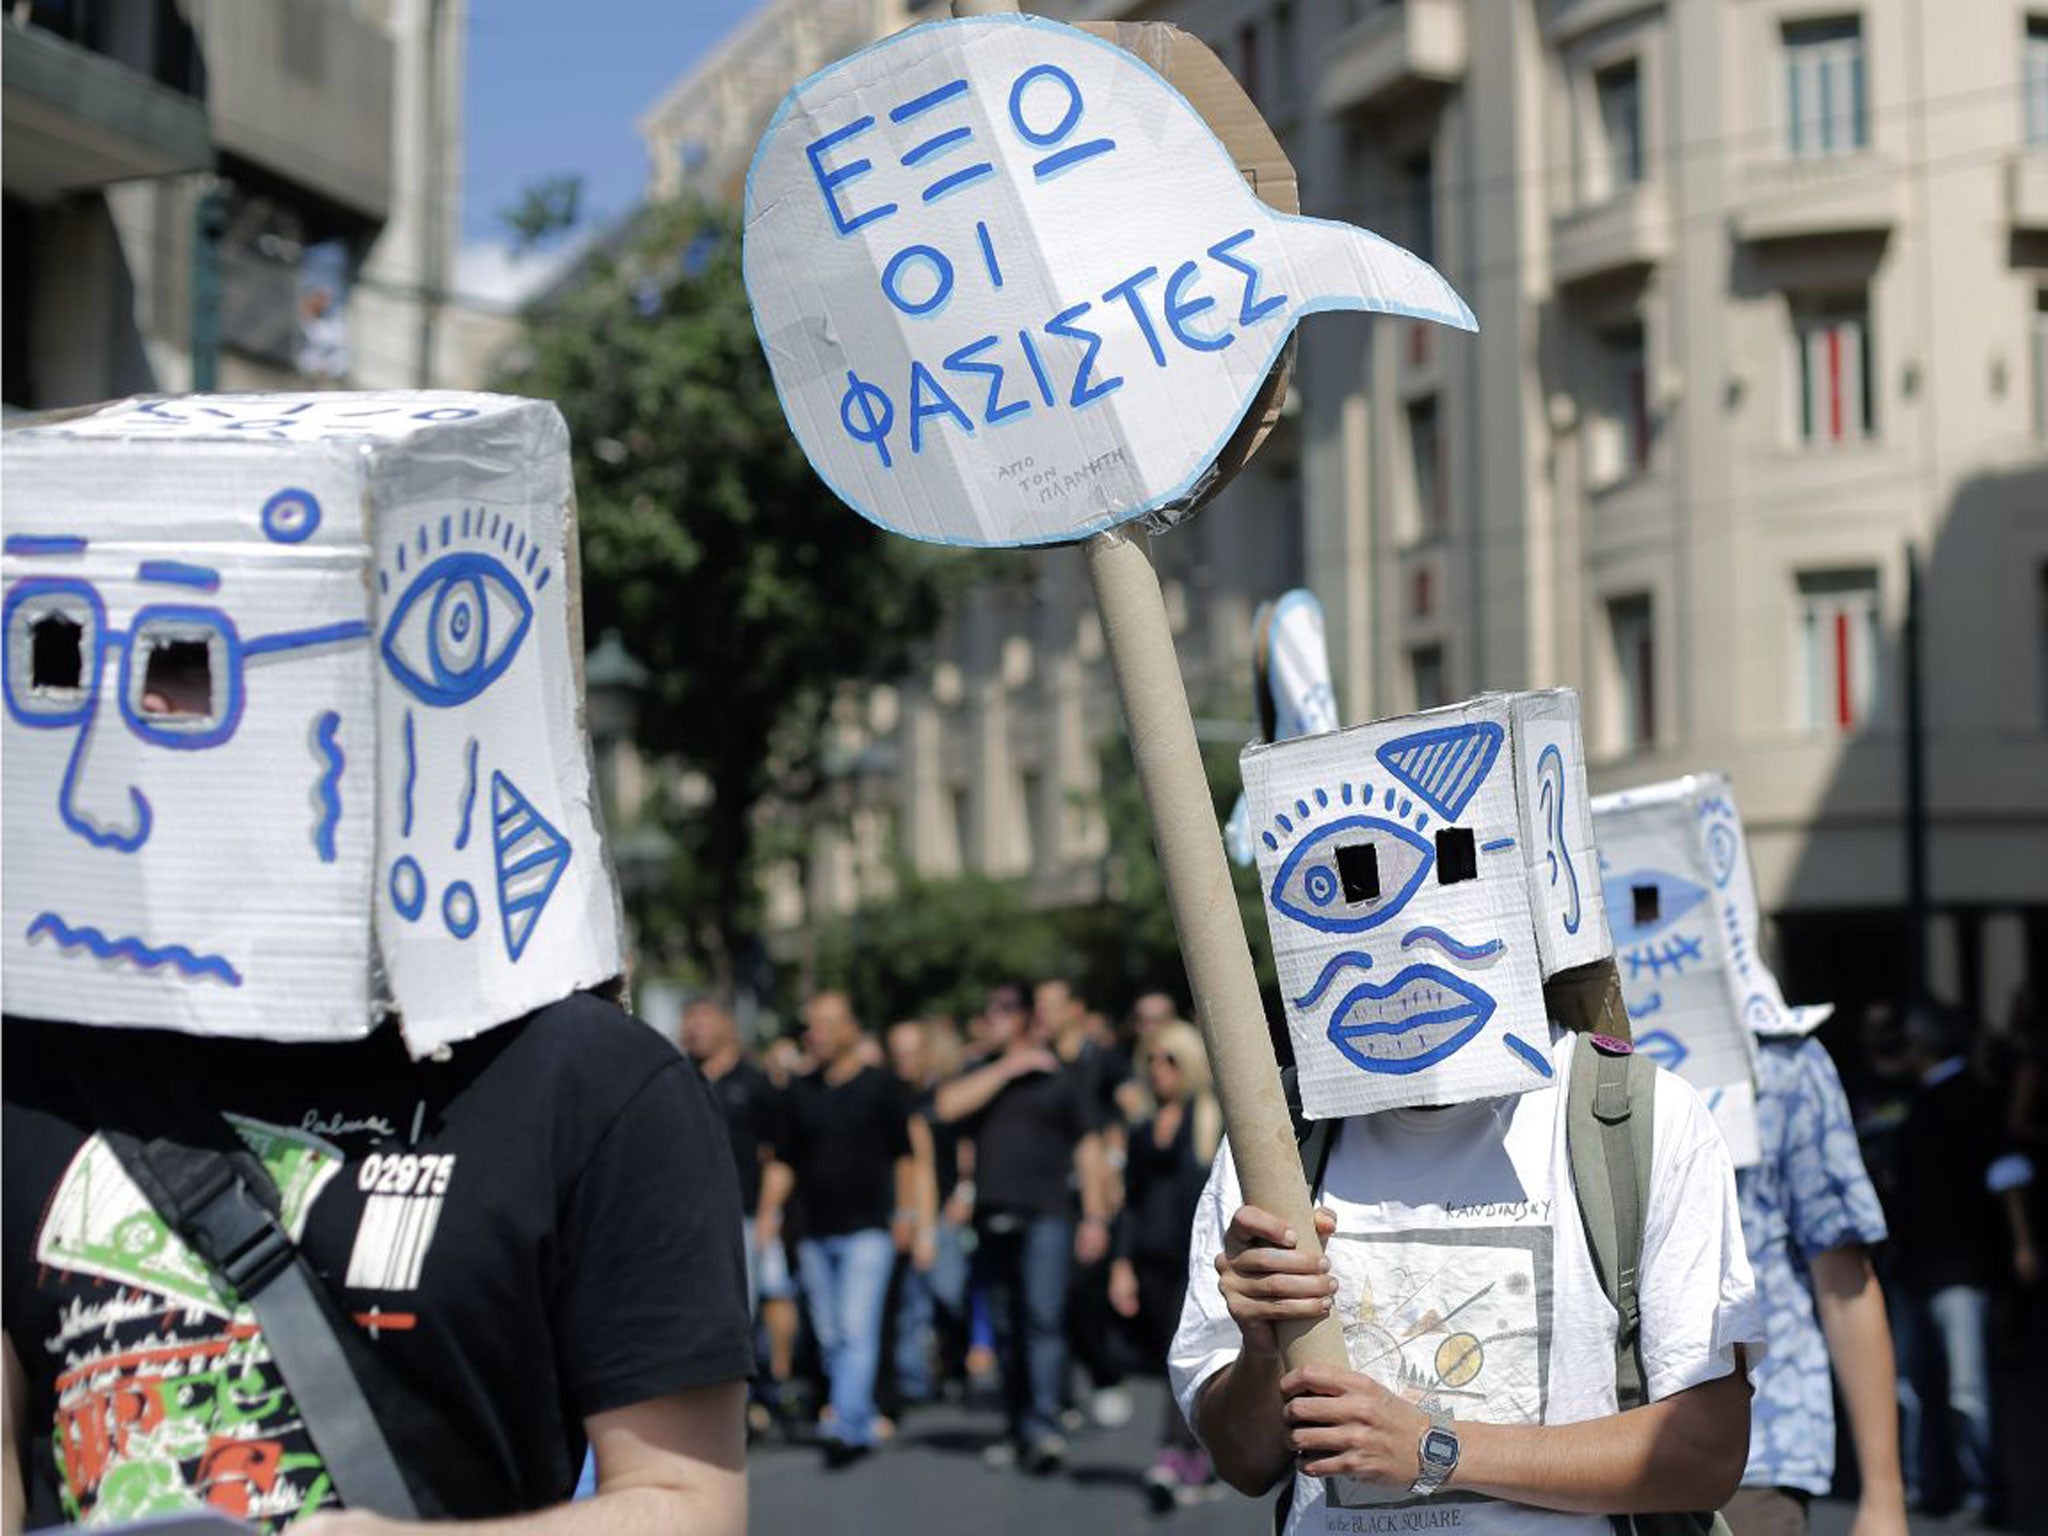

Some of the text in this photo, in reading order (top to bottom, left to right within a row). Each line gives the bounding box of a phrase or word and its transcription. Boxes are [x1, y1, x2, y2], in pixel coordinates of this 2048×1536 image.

[804, 62, 1117, 238] ΕΞΩ
[881, 221, 1004, 316] ΟΙ
[839, 228, 1289, 468] ΦΑΣΙΣΤΕΣ
[999, 456, 1034, 480] ΑΠΟ
[1018, 466, 1057, 492] ΤΟΝ
[1351, 1514, 1397, 1533] BLACK
[1402, 1508, 1461, 1532] SQUARE
